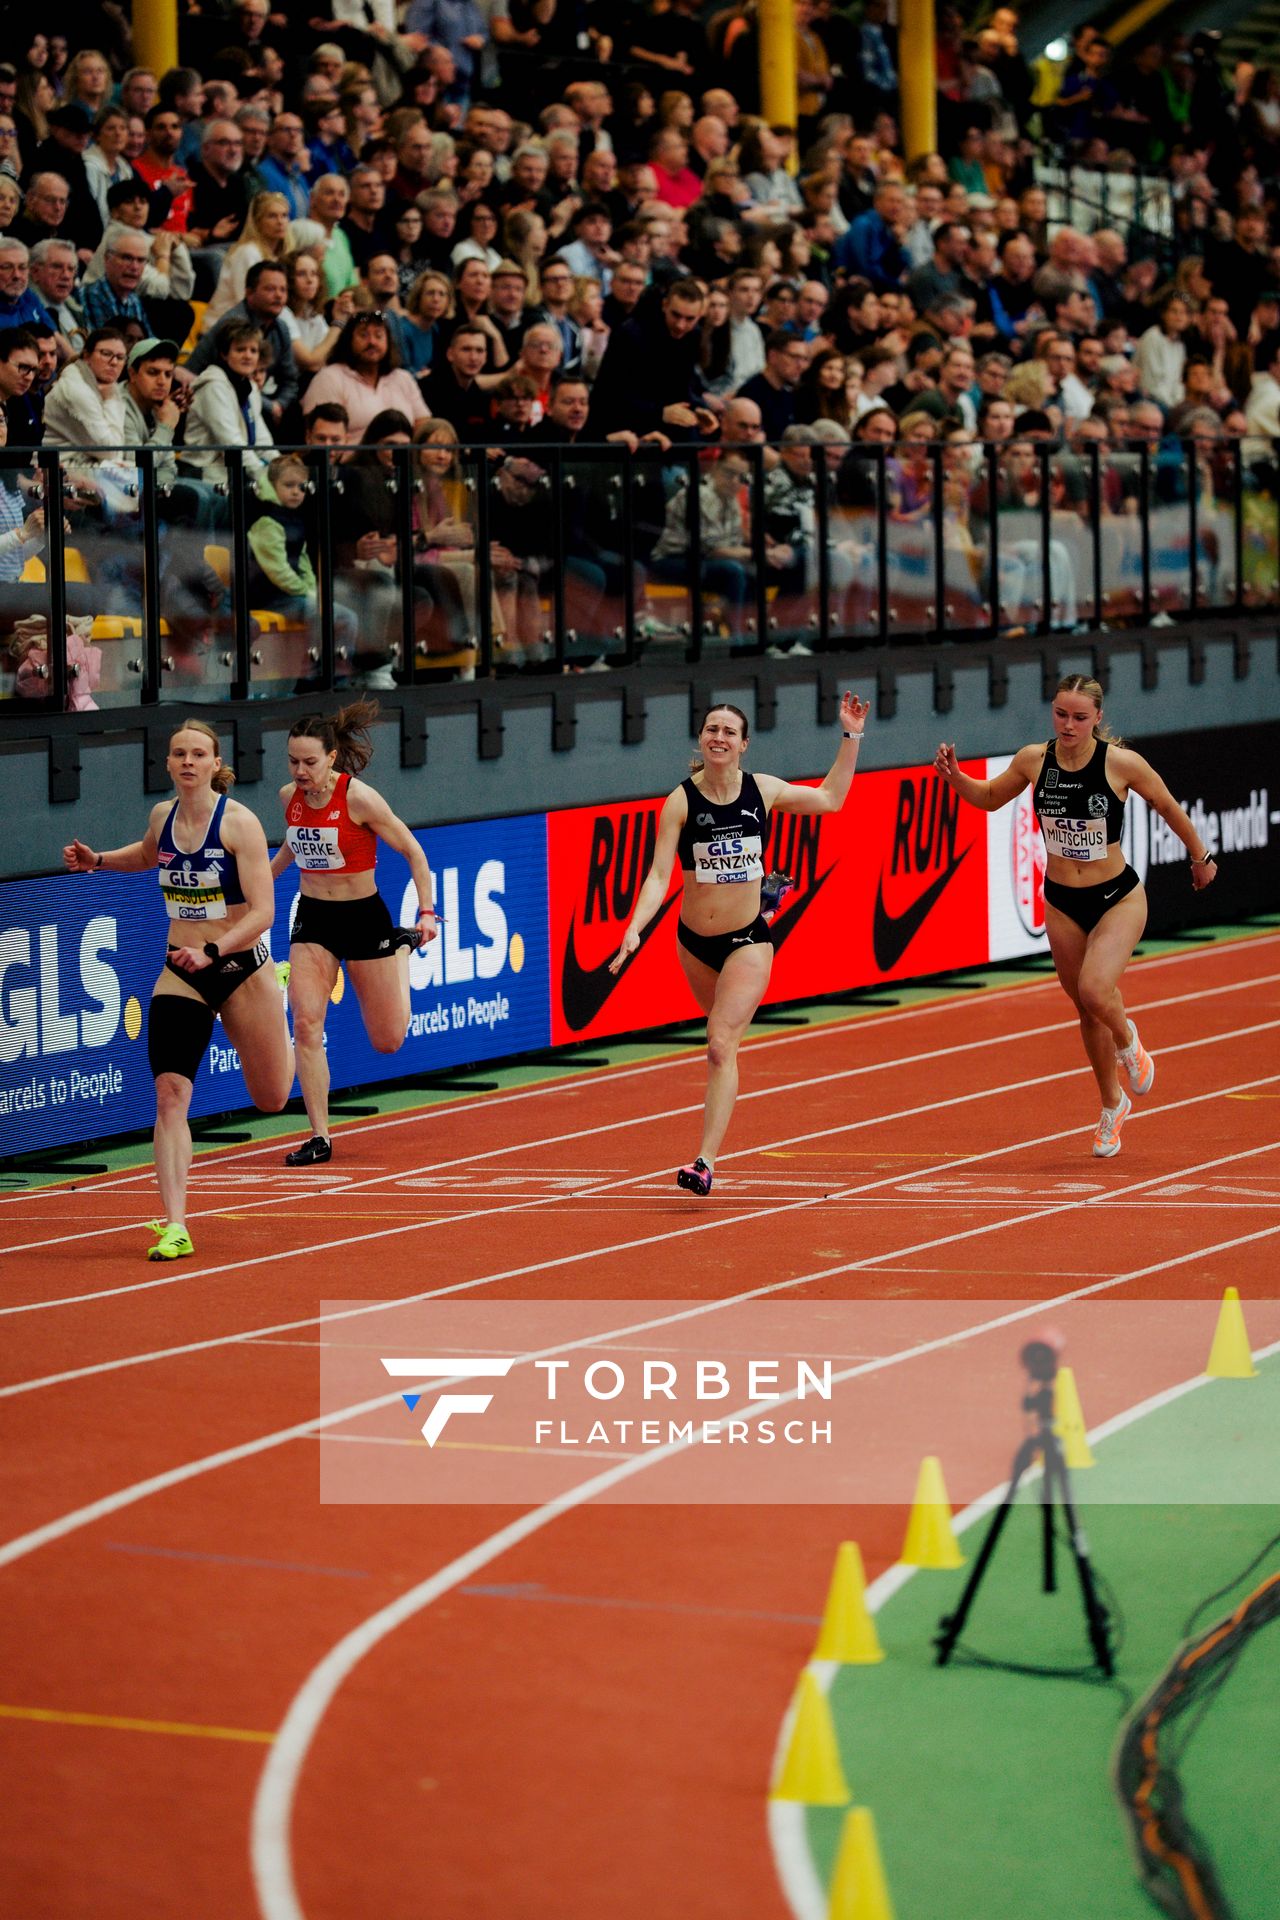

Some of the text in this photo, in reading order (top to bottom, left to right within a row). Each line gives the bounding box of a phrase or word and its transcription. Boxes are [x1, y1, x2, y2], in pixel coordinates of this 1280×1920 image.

[891, 775, 960, 876] RUN
[712, 830, 744, 841] VIACTIV
[1047, 828, 1103, 847] MILTSCHUS
[291, 841, 335, 856] DIERKE
[699, 853, 757, 870] BENZIN
[451, 1002, 466, 1030] to
[467, 992, 509, 1032] People
[50, 1076, 67, 1105] to
[70, 1063, 123, 1107] People
